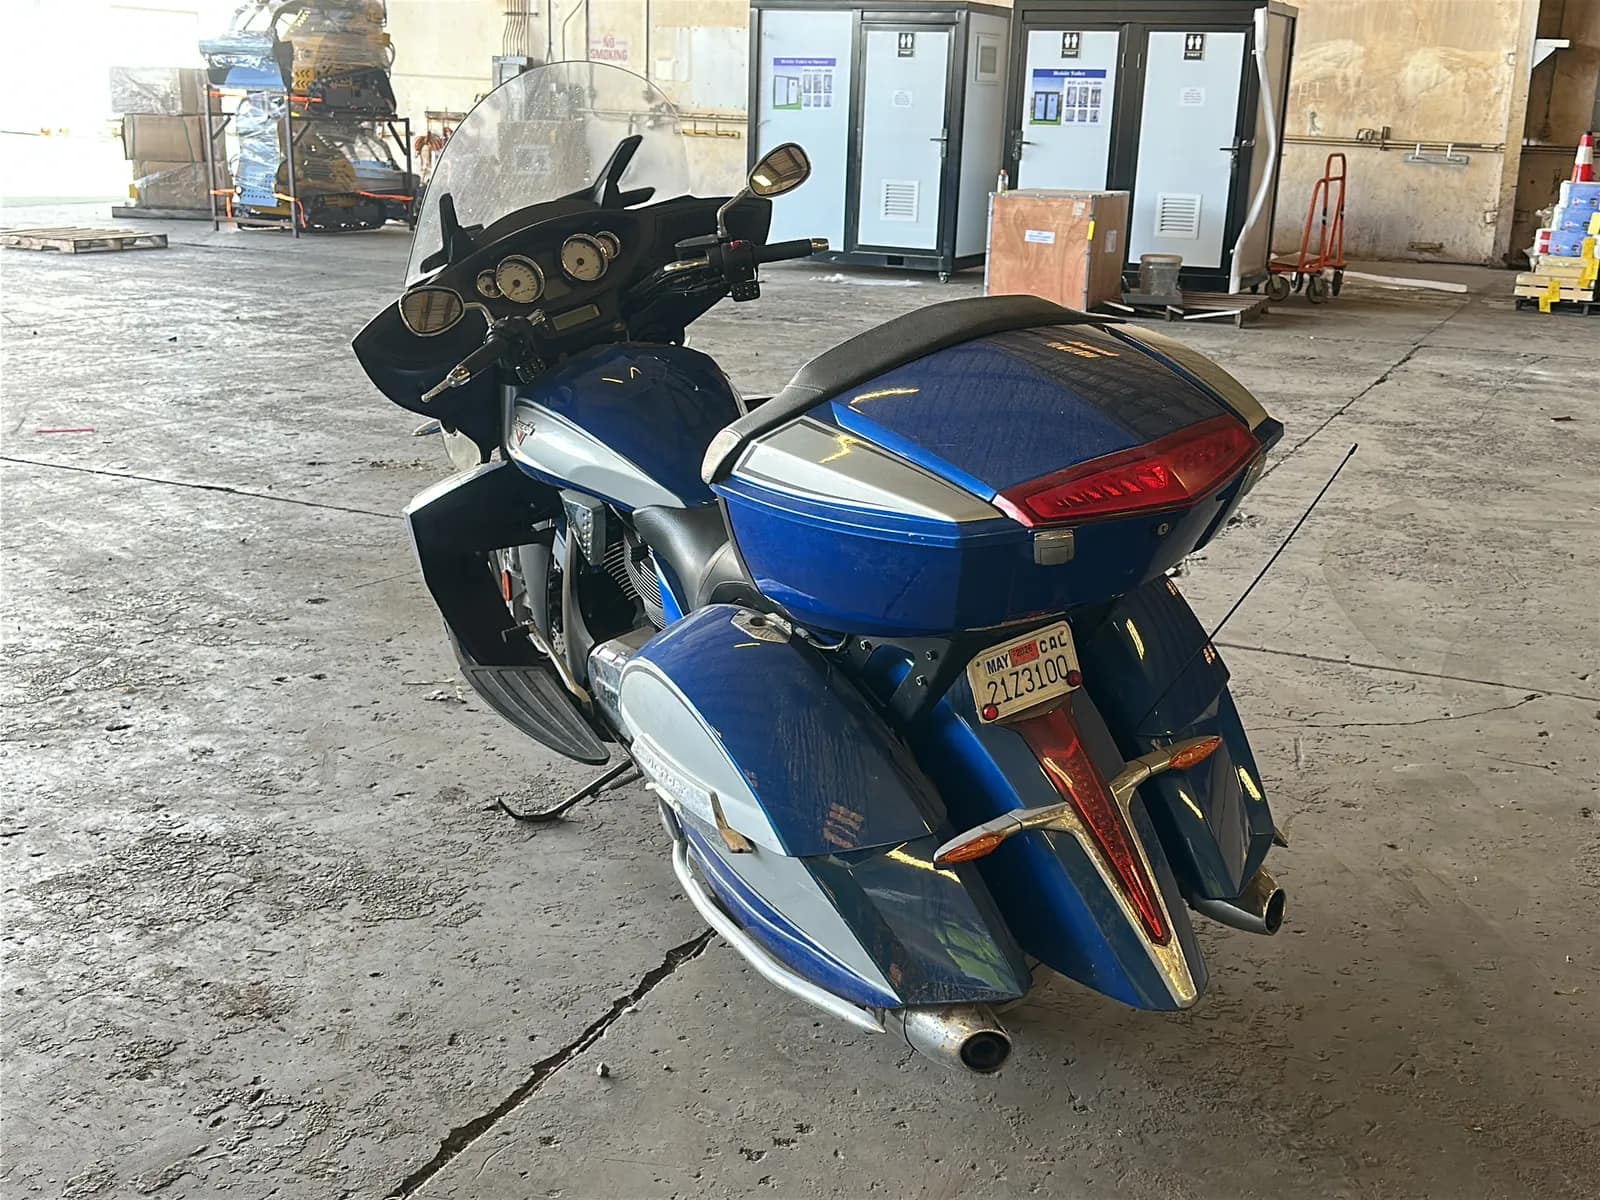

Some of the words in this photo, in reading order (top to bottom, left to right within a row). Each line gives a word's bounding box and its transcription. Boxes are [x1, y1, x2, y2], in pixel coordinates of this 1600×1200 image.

[591, 49, 628, 61] SMOKING
[603, 36, 615, 48] NO
[986, 654, 1009, 674] MAY
[1039, 634, 1067, 654] CAL
[987, 655, 1069, 706] 21Z3100
